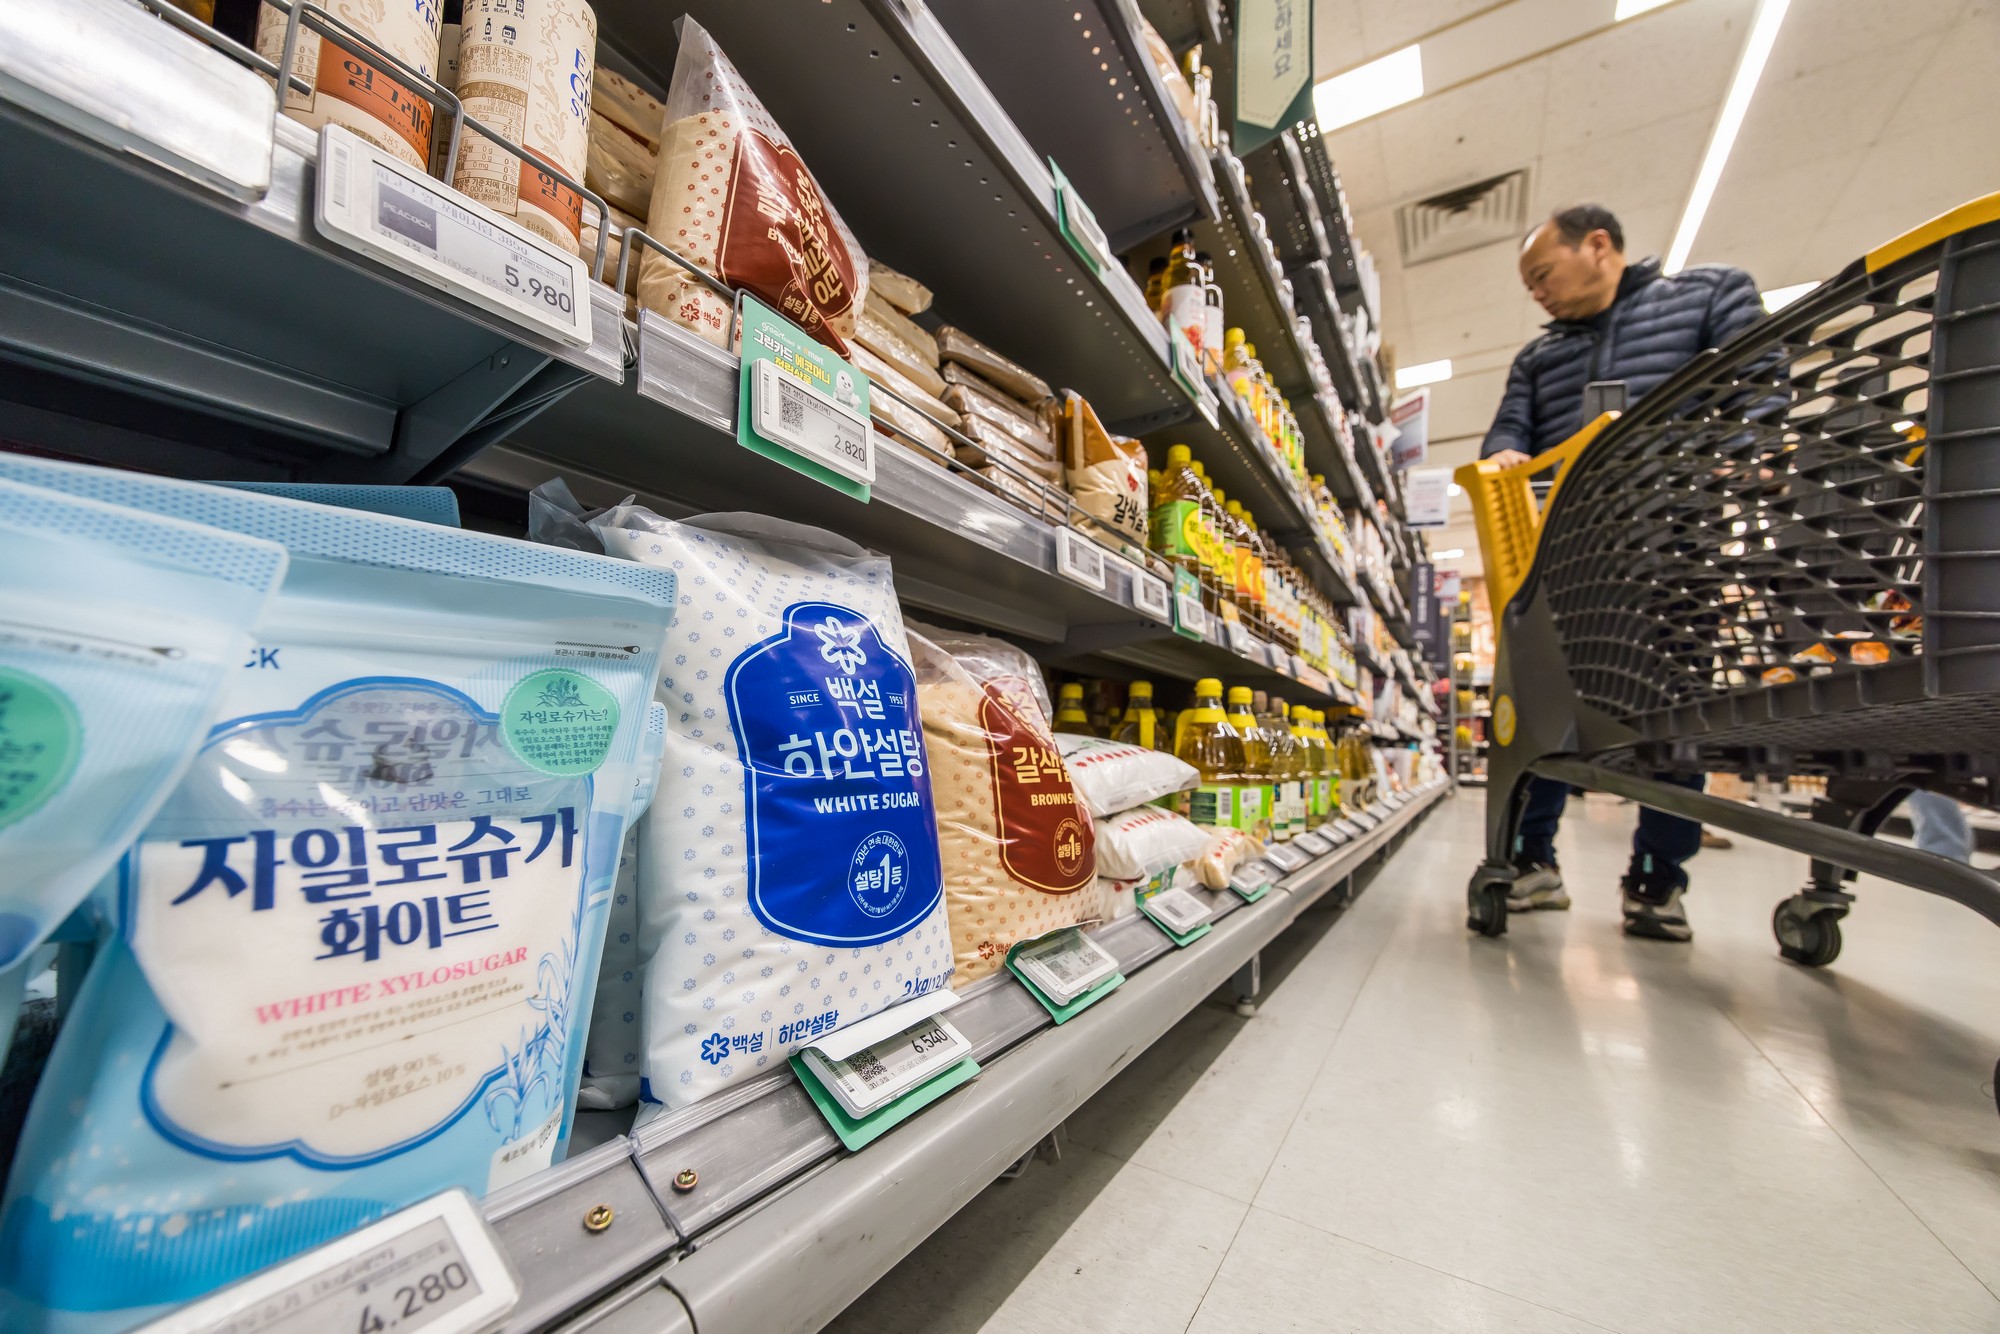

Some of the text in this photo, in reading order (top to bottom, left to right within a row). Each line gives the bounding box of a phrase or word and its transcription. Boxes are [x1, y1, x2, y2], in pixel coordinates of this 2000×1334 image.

[495, 92, 508, 100] 275
[382, 201, 433, 232] PEACOCK
[753, 327, 794, 363] 그린카드
[789, 692, 905, 706] SINCE 1953
[825, 676, 887, 721] 백설
[519, 708, 609, 724] 자일로슈가는?
[778, 727, 924, 781] 하얀설탕
[408, 788, 470, 814] 단맛은
[476, 784, 533, 808] 그대로
[814, 791, 920, 815] WHITE SUGAR
[1031, 793, 1068, 807] BROWN
[172, 806, 579, 912] 자일로슈가
[315, 889, 500, 962] 화이트
[255, 982, 372, 1026] WHITE
[377, 946, 528, 998] XYLOSUGAR
[732, 1009, 840, 1055] 백설 하얀설탕
